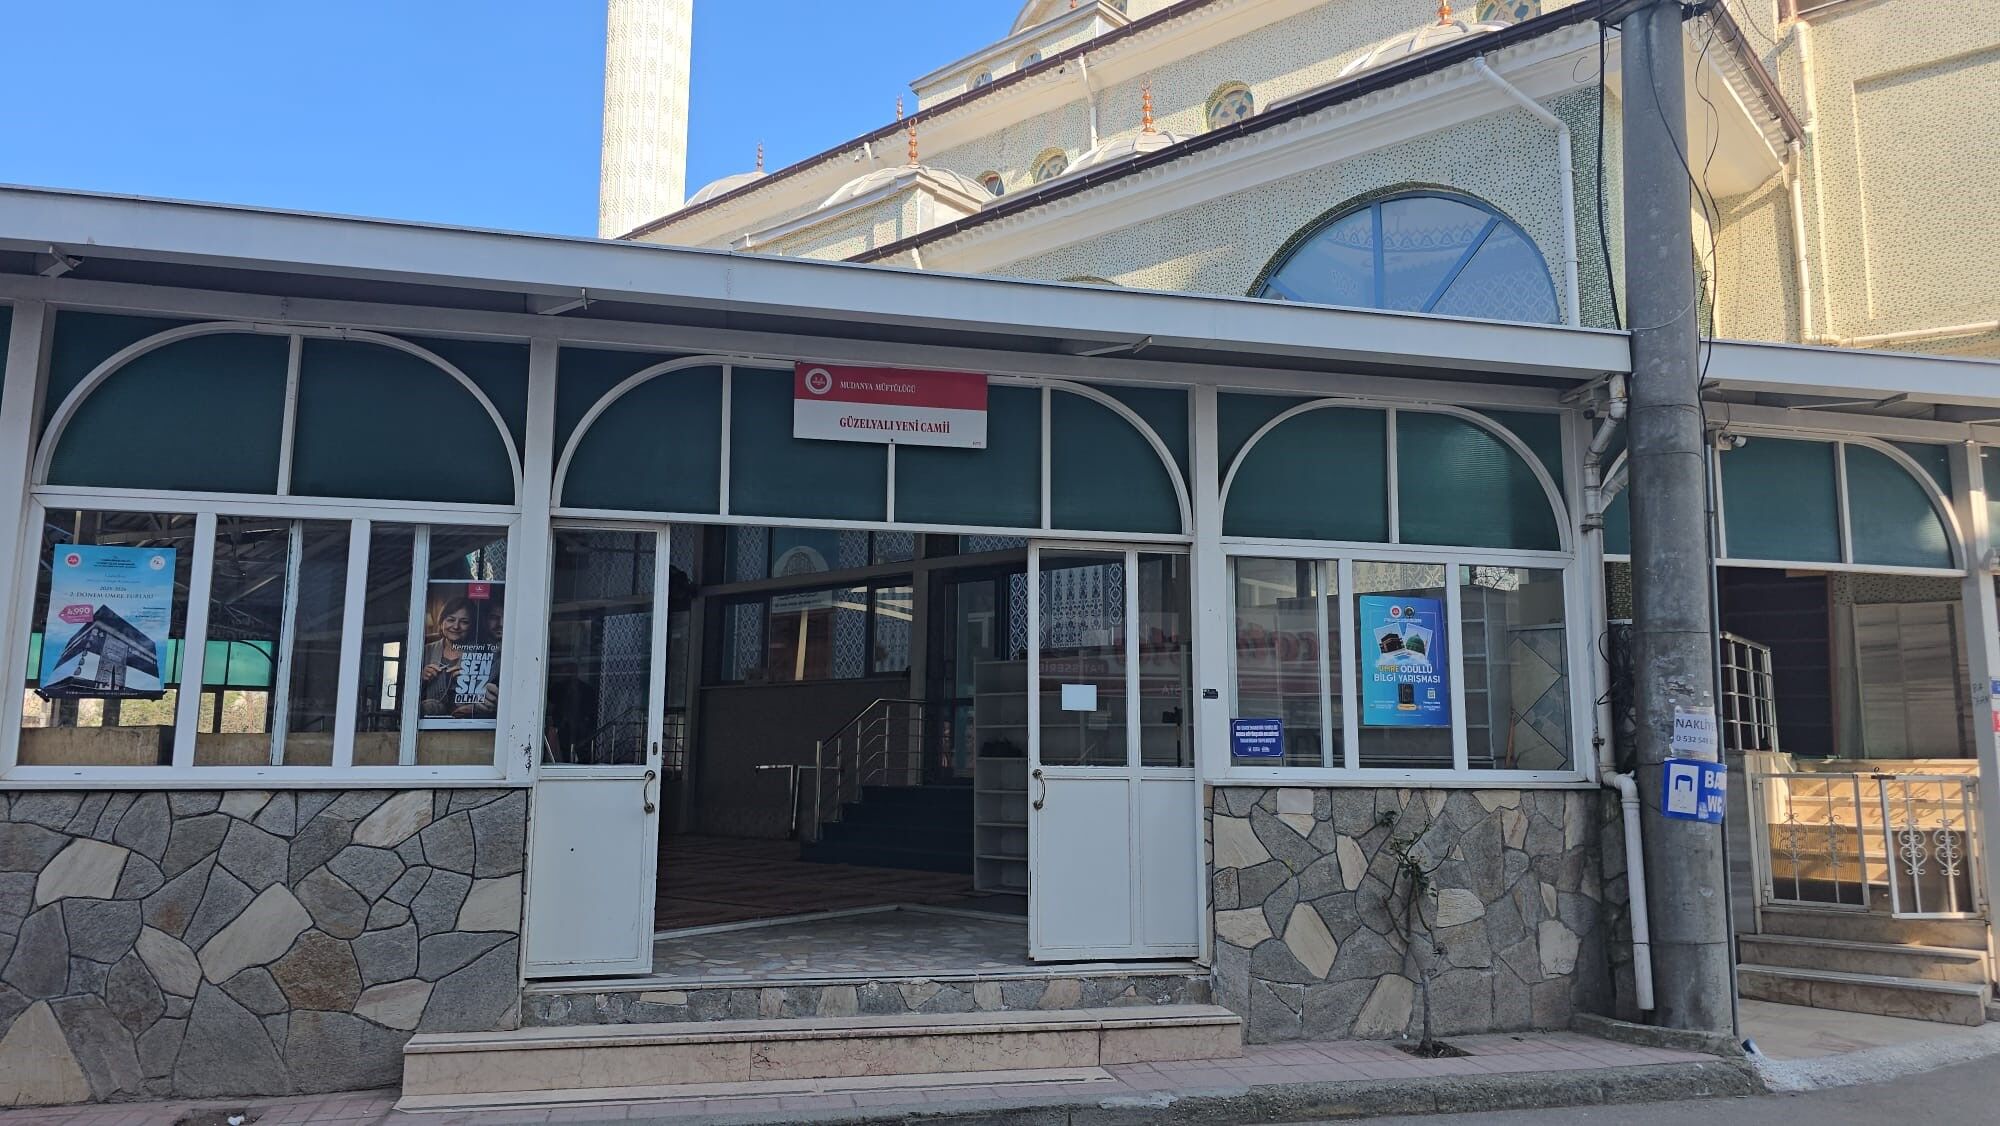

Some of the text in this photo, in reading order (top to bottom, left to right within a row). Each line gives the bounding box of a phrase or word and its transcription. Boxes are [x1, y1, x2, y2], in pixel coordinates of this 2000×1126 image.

[840, 381, 917, 393] MUDANYA MÜFTÜLÜĞÜ
[839, 415, 950, 434] GÜZELYALI YENİ CAMİİ
[452, 643, 485, 651] Kemerini
[462, 652, 494, 661] BAYRAM
[461, 660, 493, 675] SEN
[1379, 663, 1433, 674] UMRE ÖDÜLLÜ
[1373, 672, 1440, 684] BİLGİ YARIŞMASI
[455, 674, 489, 694] SİZ
[455, 694, 485, 703] OLMAZ
[1683, 735, 1696, 743] 532
